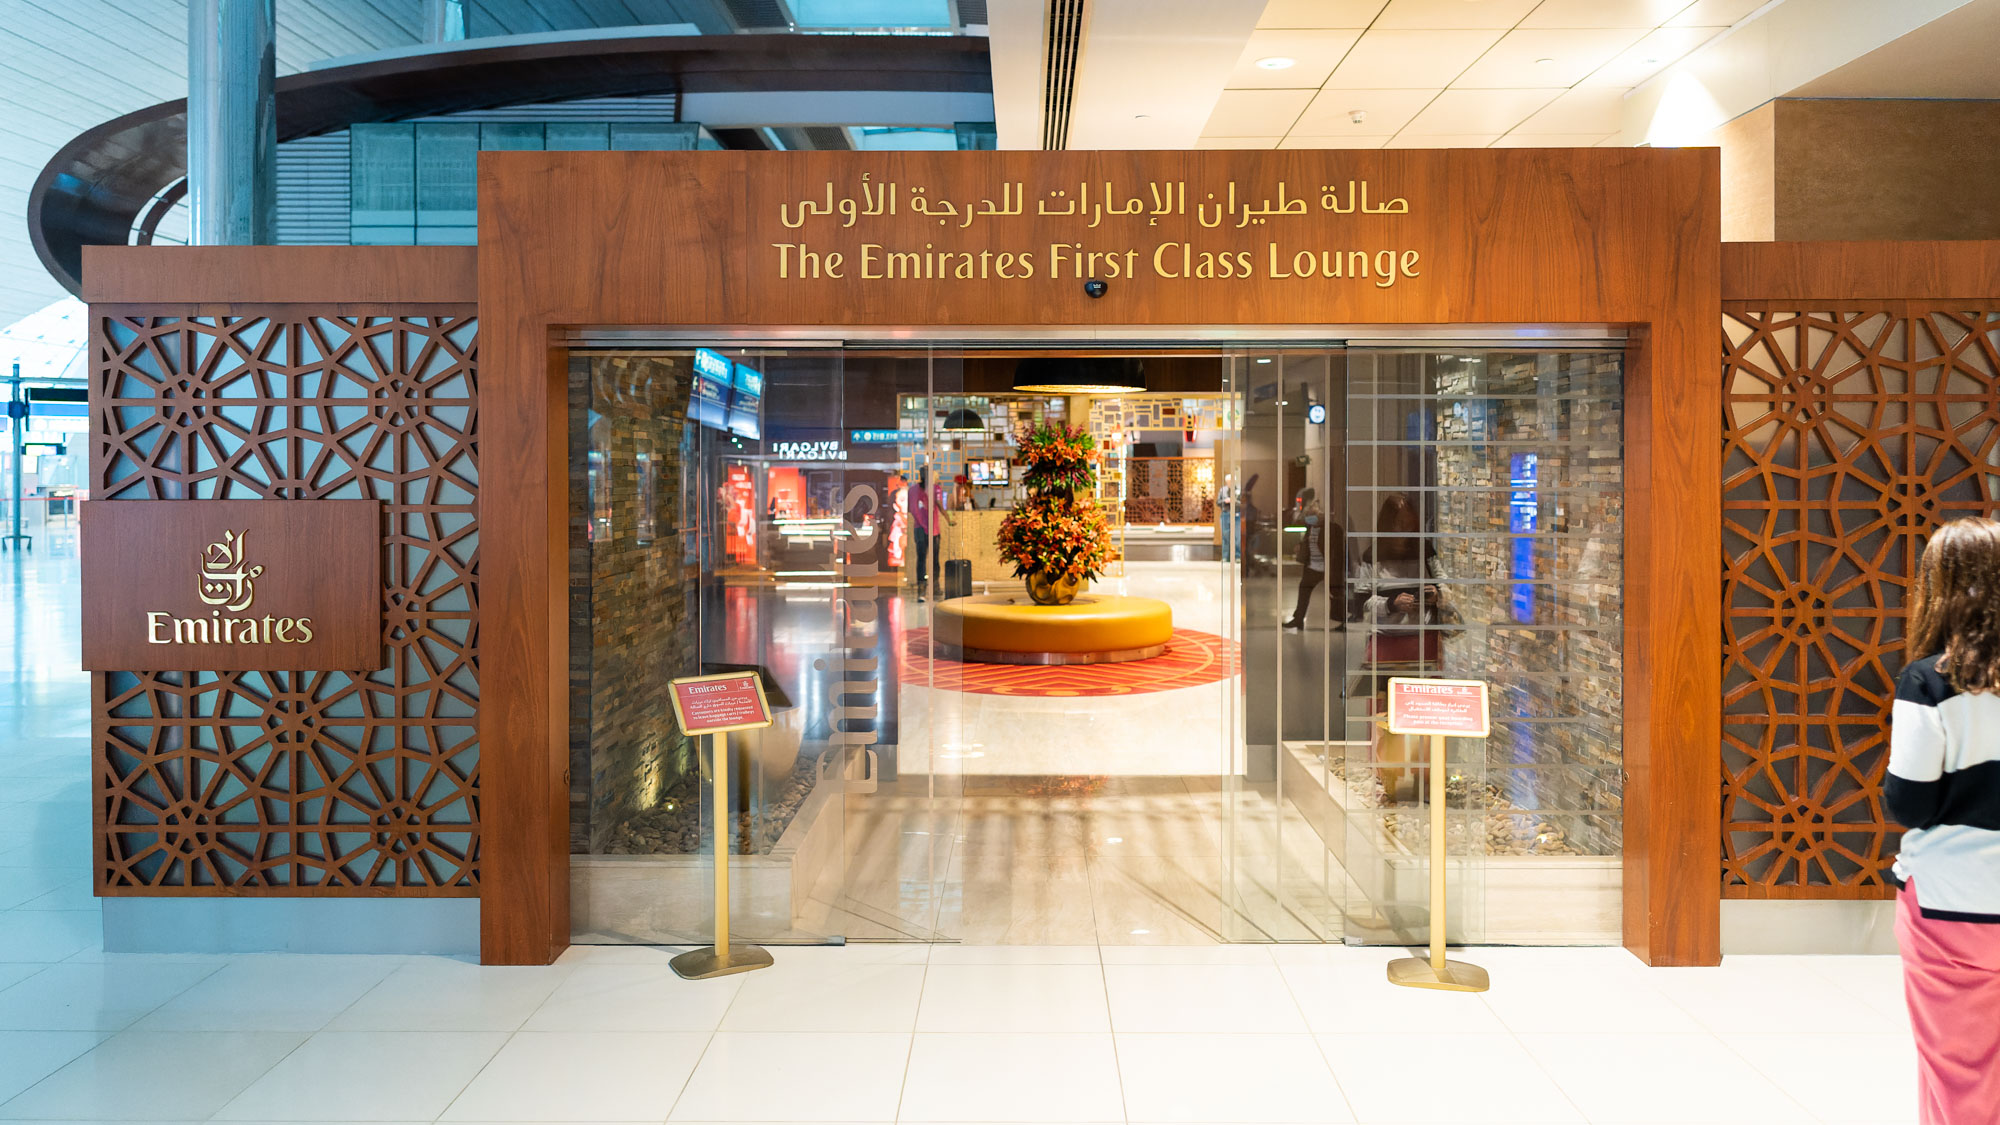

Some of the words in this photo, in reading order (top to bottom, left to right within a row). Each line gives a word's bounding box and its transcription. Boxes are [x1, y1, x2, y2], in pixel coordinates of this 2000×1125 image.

[781, 172, 896, 228] الأولى
[910, 182, 1023, 228] للدرجة
[1038, 181, 1185, 228] الإمارات
[1198, 181, 1308, 228] طيران
[1320, 180, 1409, 215] صالة
[771, 243, 844, 279] The
[861, 243, 1034, 279] Emirates
[1050, 242, 1139, 279] First
[1153, 242, 1253, 279] Class
[1269, 242, 1420, 288] Lounge
[146, 609, 314, 644] Emirates
[813, 484, 879, 794] Emirates
[688, 684, 728, 695] Emirates
[1403, 684, 1454, 695] Emirates
